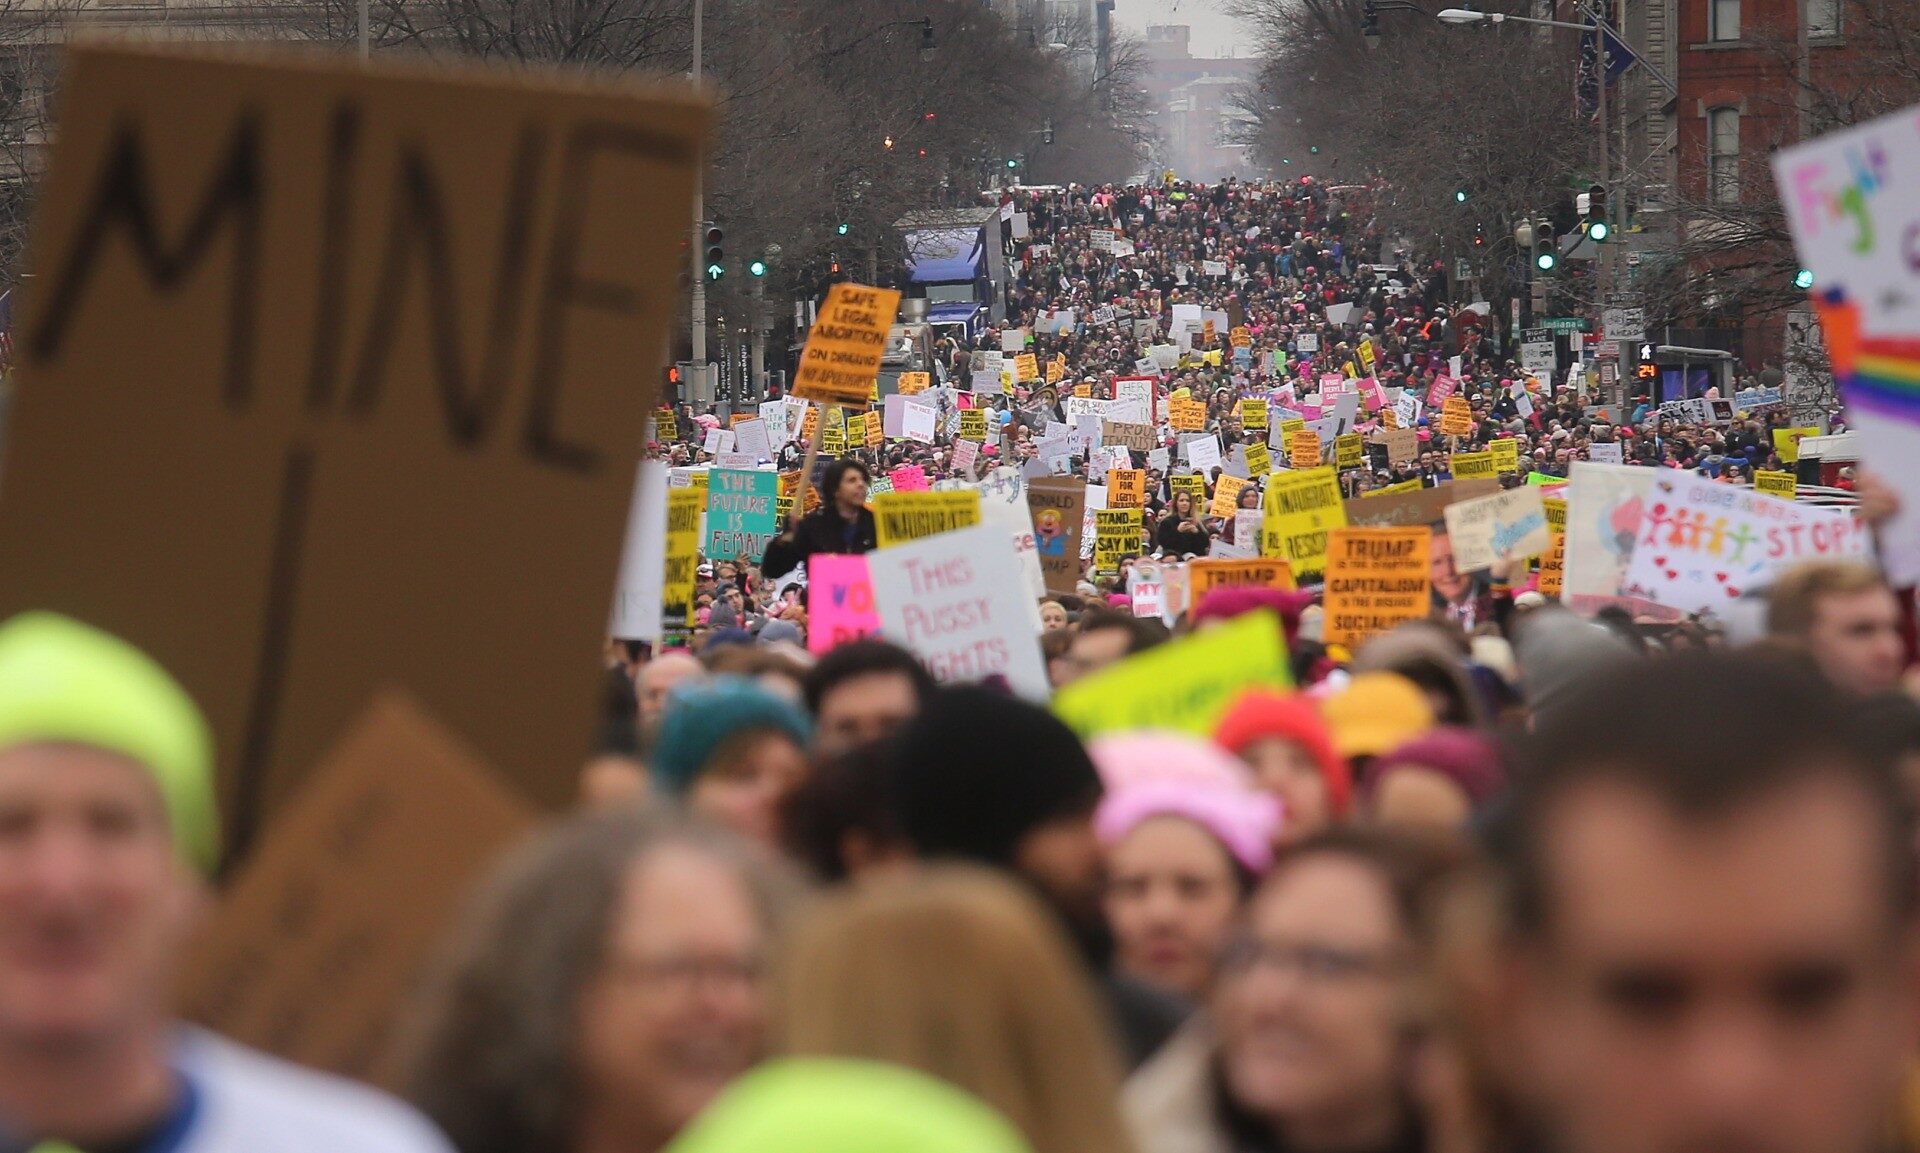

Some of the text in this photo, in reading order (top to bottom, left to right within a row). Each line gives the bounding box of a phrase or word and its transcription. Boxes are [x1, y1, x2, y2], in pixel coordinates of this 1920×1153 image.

[28, 92, 700, 480] MINE
[833, 308, 876, 327] LEGAL
[1543, 319, 1576, 329] Indiana
[814, 325, 885, 345] ABORTION
[1526, 329, 1548, 337] RIGHT
[809, 348, 828, 361] ON
[1638, 364, 1655, 378] 24
[1123, 382, 1146, 391] HER
[1795, 412, 1822, 421] STOP
[961, 422, 975, 430] SAY
[1112, 422, 1157, 437] PROUD
[1102, 434, 1156, 450] FEMINIST
[1116, 471, 1137, 480] FIGHT
[1454, 460, 1493, 476] INAUGURATE
[718, 473, 755, 492] THE
[1120, 481, 1133, 491] FOR
[1171, 477, 1193, 486] STAND
[1757, 477, 1794, 493] INAUGURATE
[711, 494, 769, 515] FUTURE
[777, 498, 794, 507] TAND
[727, 512, 743, 532] IS
[1096, 512, 1129, 524] STAND
[1097, 537, 1139, 552] SAY NO
[1766, 517, 1864, 558] STOP!
[1346, 539, 1417, 559] TRUMP
[1104, 552, 1120, 564] RAC
[900, 555, 974, 597] THIS
[1206, 568, 1276, 587] TRUMP
[1330, 579, 1425, 592] CAPITALISM
[901, 596, 990, 645] PUSSY
